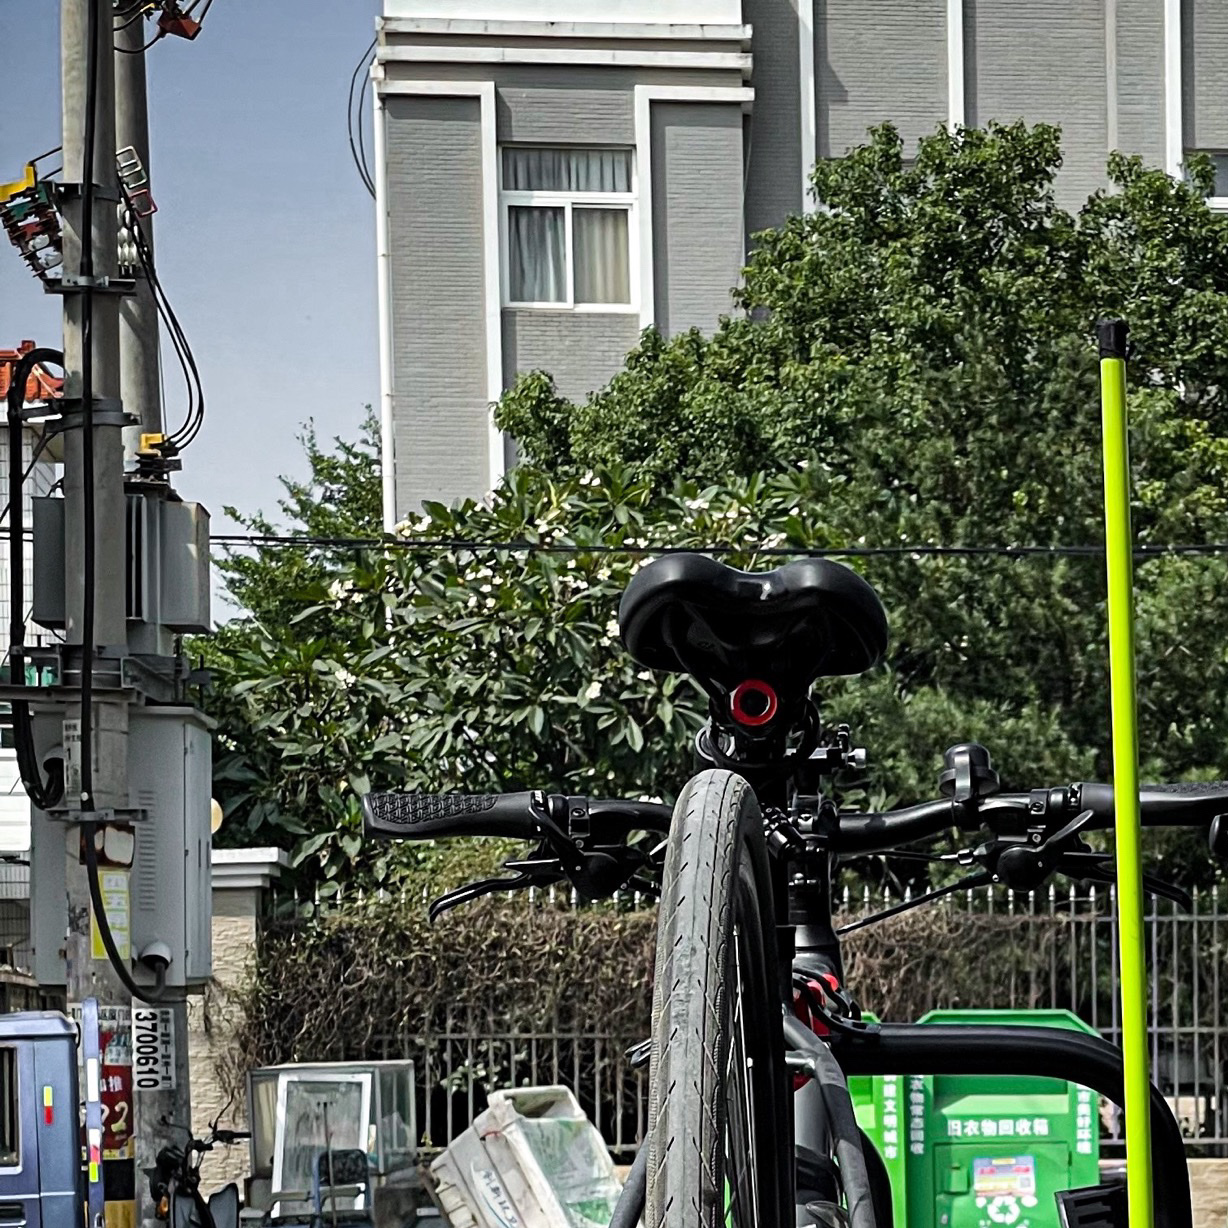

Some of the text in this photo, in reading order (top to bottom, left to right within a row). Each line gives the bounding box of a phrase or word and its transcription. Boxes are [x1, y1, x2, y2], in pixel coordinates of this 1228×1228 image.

[135, 1011, 159, 1088] 3700610
[947, 1118, 1049, 1136] 旧衣物回收箱
